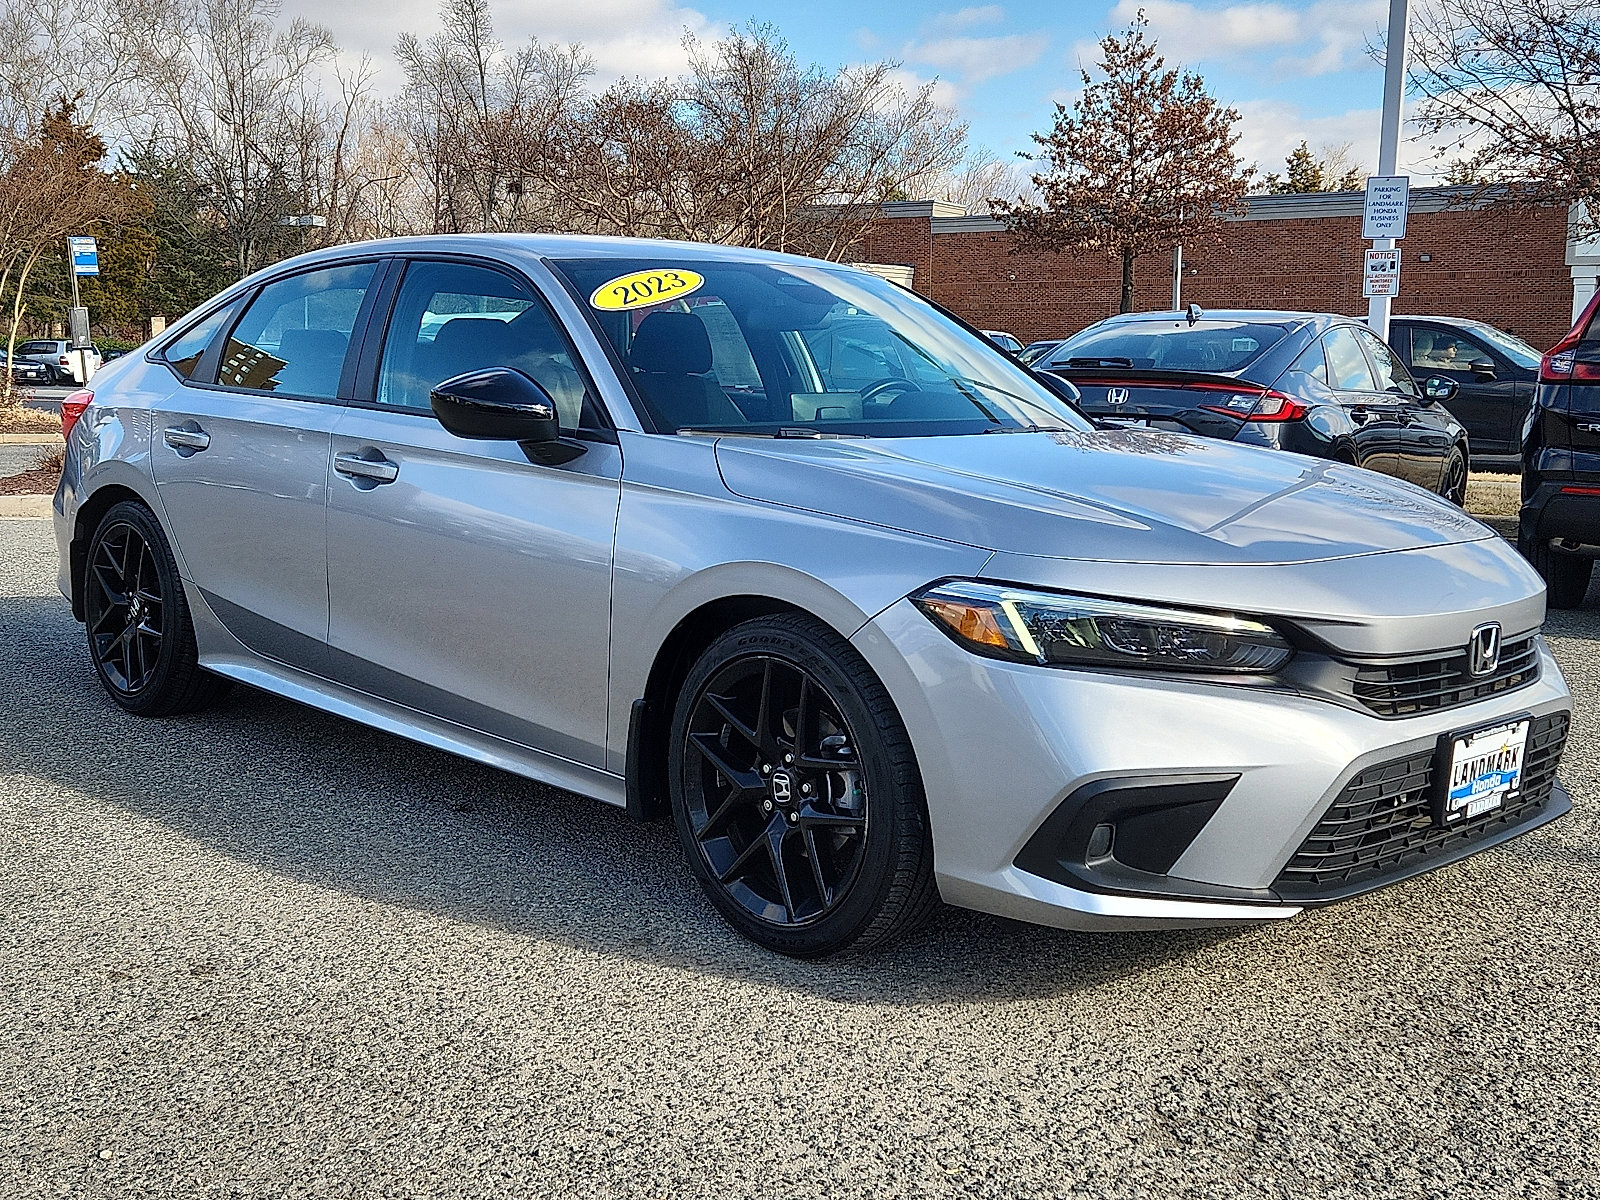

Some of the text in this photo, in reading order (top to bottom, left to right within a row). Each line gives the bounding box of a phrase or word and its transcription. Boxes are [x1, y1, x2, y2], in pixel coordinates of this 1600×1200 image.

[1369, 252, 1396, 260] NOTICE
[612, 272, 687, 306] 2023
[1453, 746, 1521, 788] LANDMARK
[1471, 773, 1502, 795] Honda
